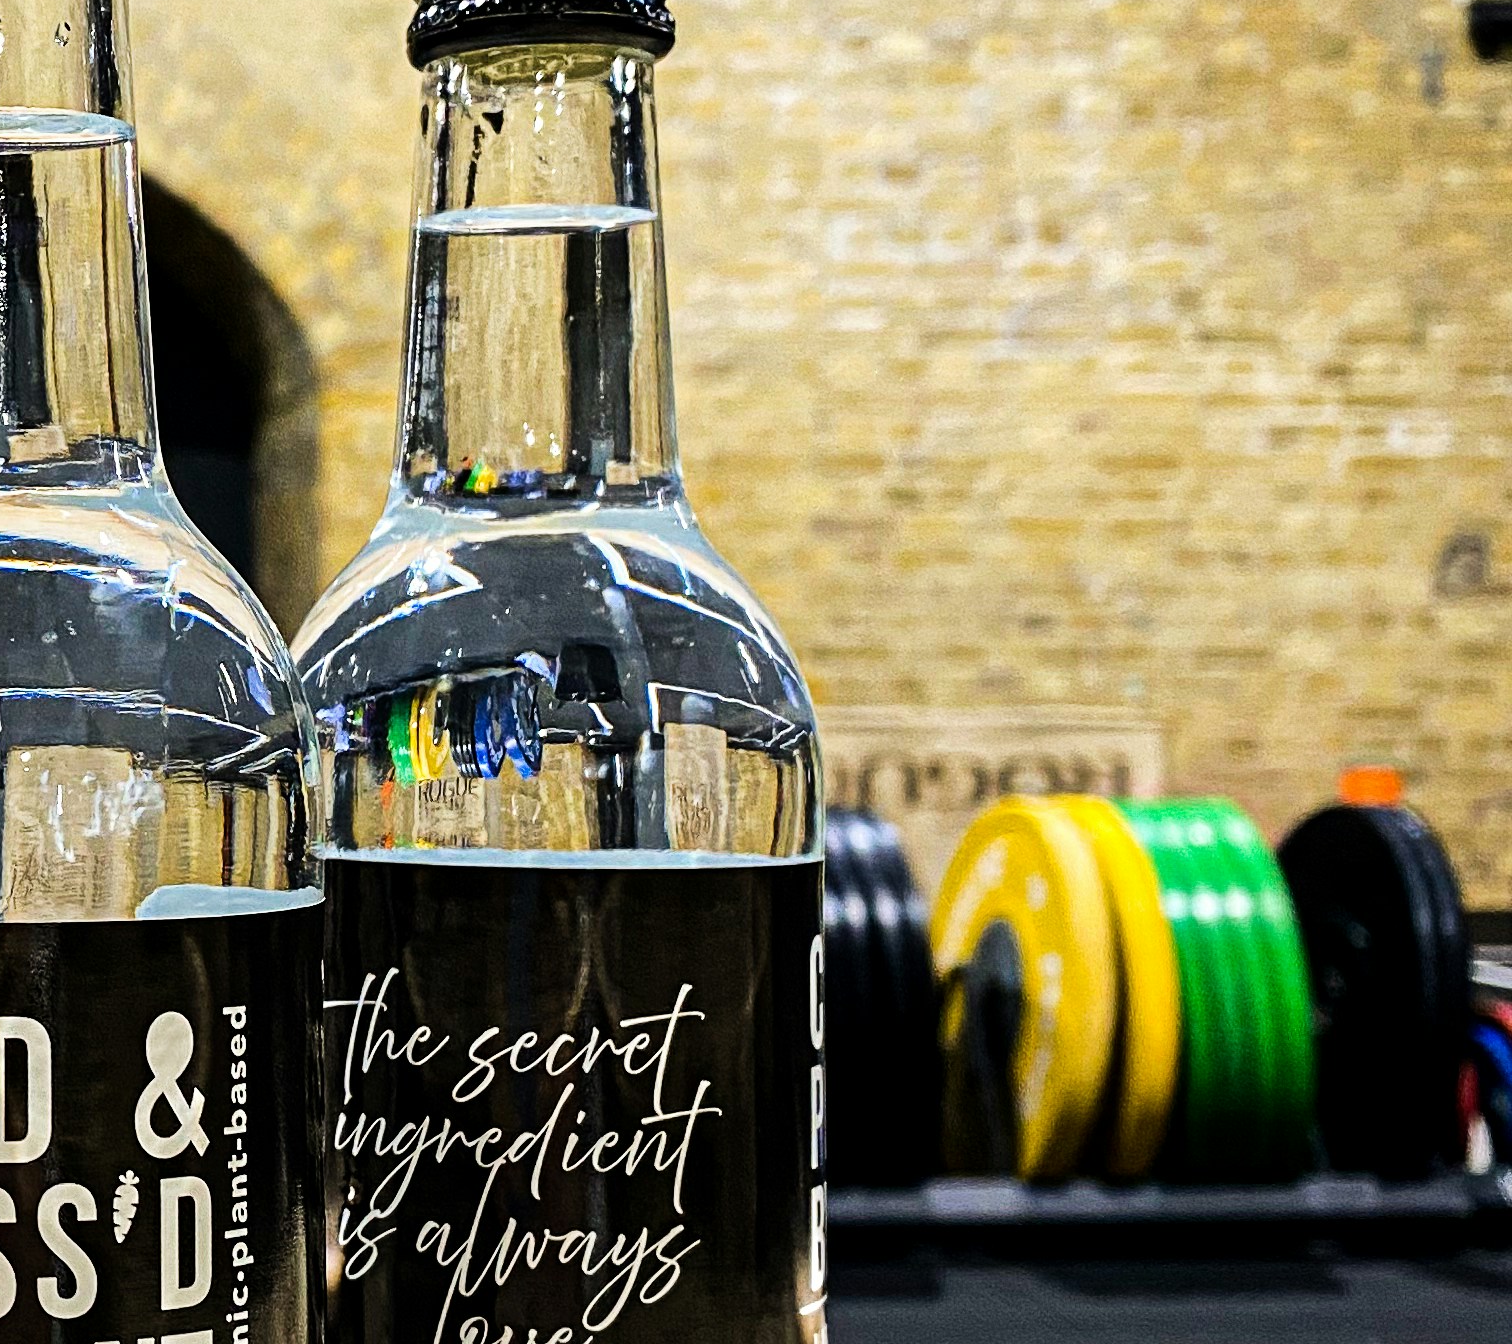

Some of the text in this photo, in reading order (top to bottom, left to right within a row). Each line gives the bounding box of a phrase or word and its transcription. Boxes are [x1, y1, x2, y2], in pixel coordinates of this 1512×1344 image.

[134, 1011, 211, 1159] &
[323, 966, 450, 1104] the
[451, 983, 706, 1116] secret
[334, 1079, 722, 1216] ingredient
[338, 1184, 397, 1280] is
[416, 1158, 701, 1332] always
